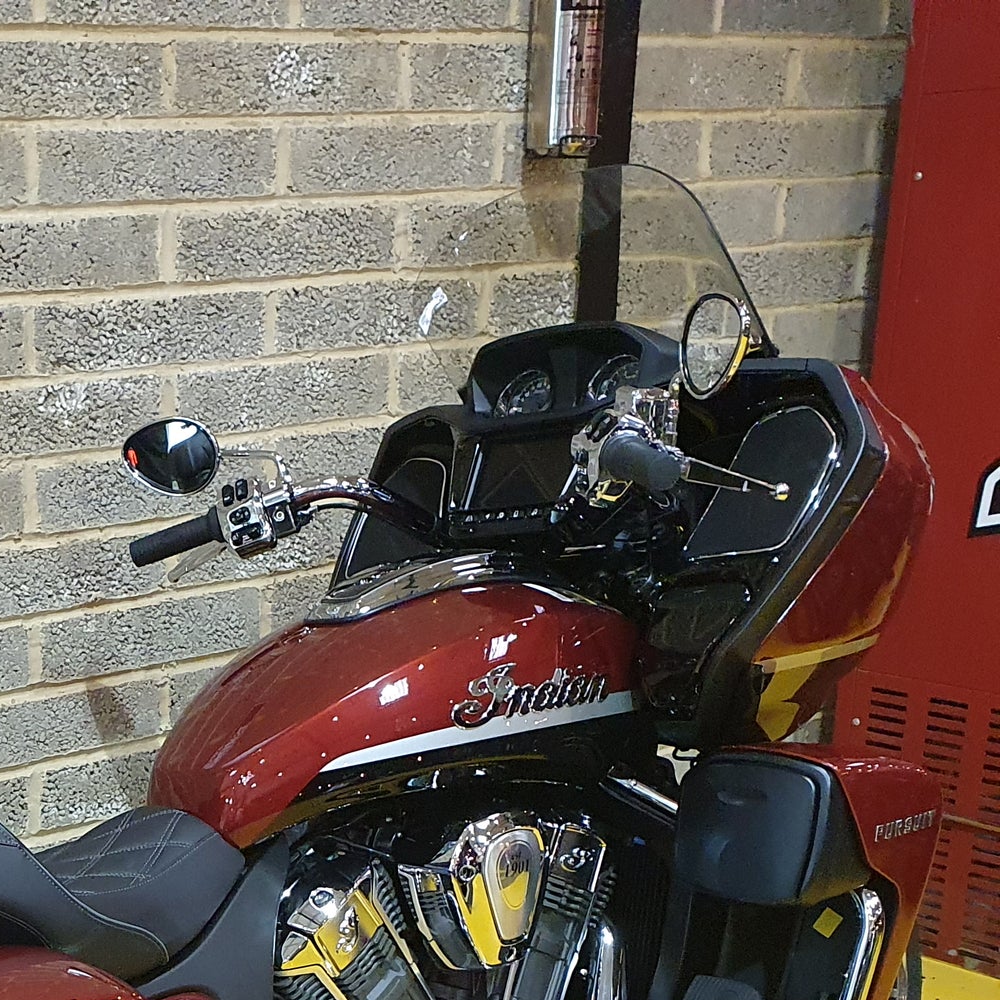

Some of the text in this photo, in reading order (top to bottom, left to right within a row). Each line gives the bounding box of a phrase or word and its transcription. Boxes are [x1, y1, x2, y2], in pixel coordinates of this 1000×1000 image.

[452, 663, 608, 730] Indian
[875, 810, 936, 842] PURSUIT
[506, 859, 529, 877] 1901
